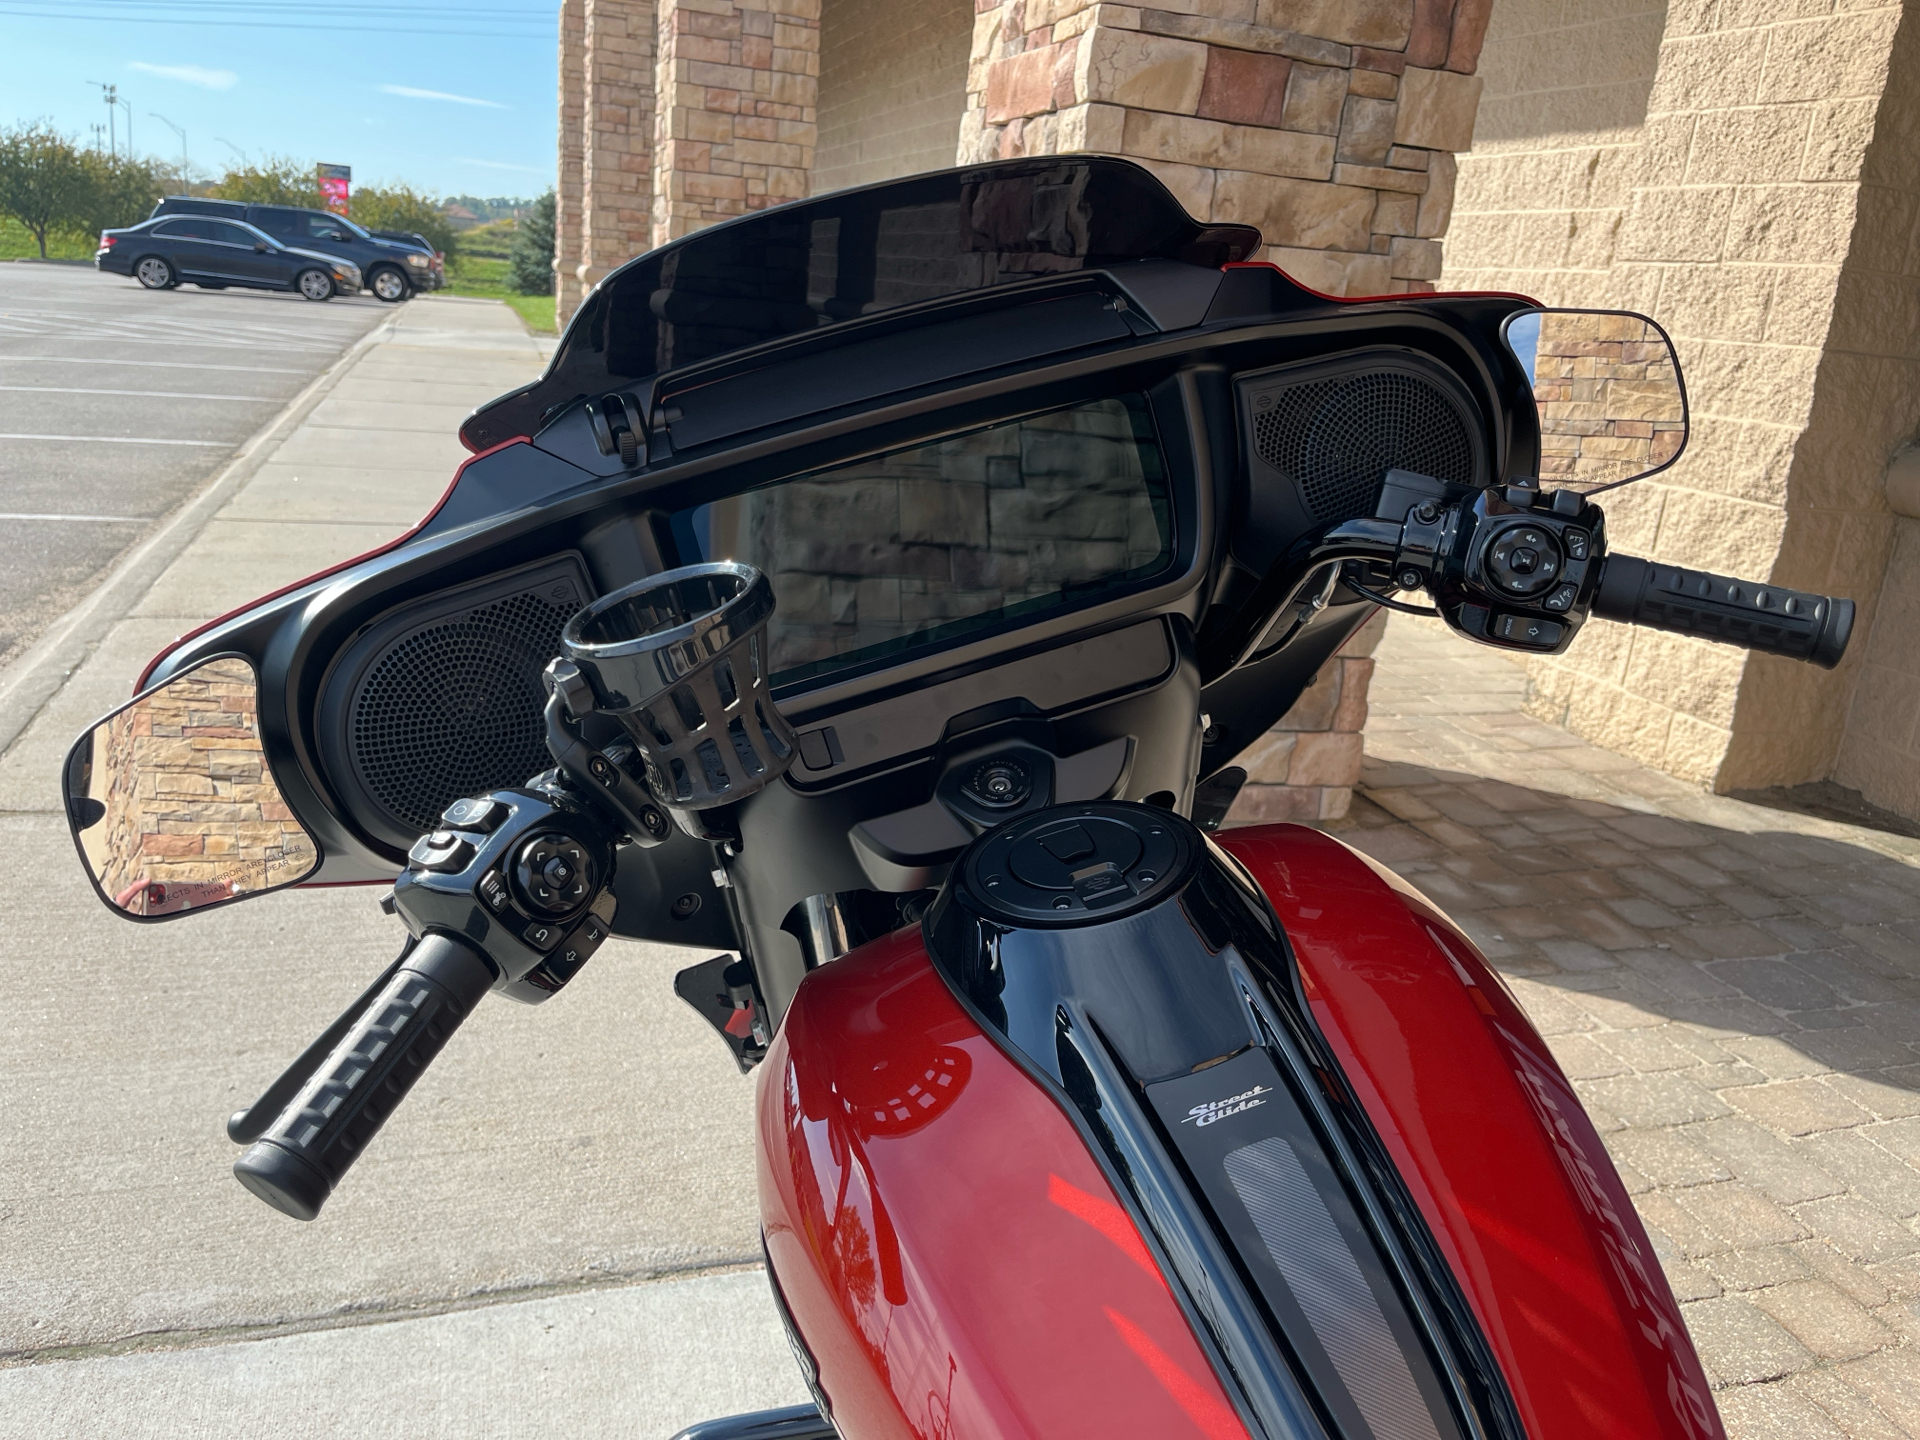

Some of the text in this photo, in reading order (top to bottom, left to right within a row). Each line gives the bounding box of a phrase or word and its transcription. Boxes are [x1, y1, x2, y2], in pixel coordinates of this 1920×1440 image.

[1591, 463, 1617, 472] MIRROR
[1636, 452, 1663, 463] CLOSER
[1591, 471, 1617, 481] APPEAR
[149, 845, 301, 908] OJECTS IN MIRROR ARE CLOSER
[201, 859, 291, 898] THAN HEY APPEAR
[1186, 1085, 1270, 1117] Street
[1195, 1099, 1266, 1127] Glide
